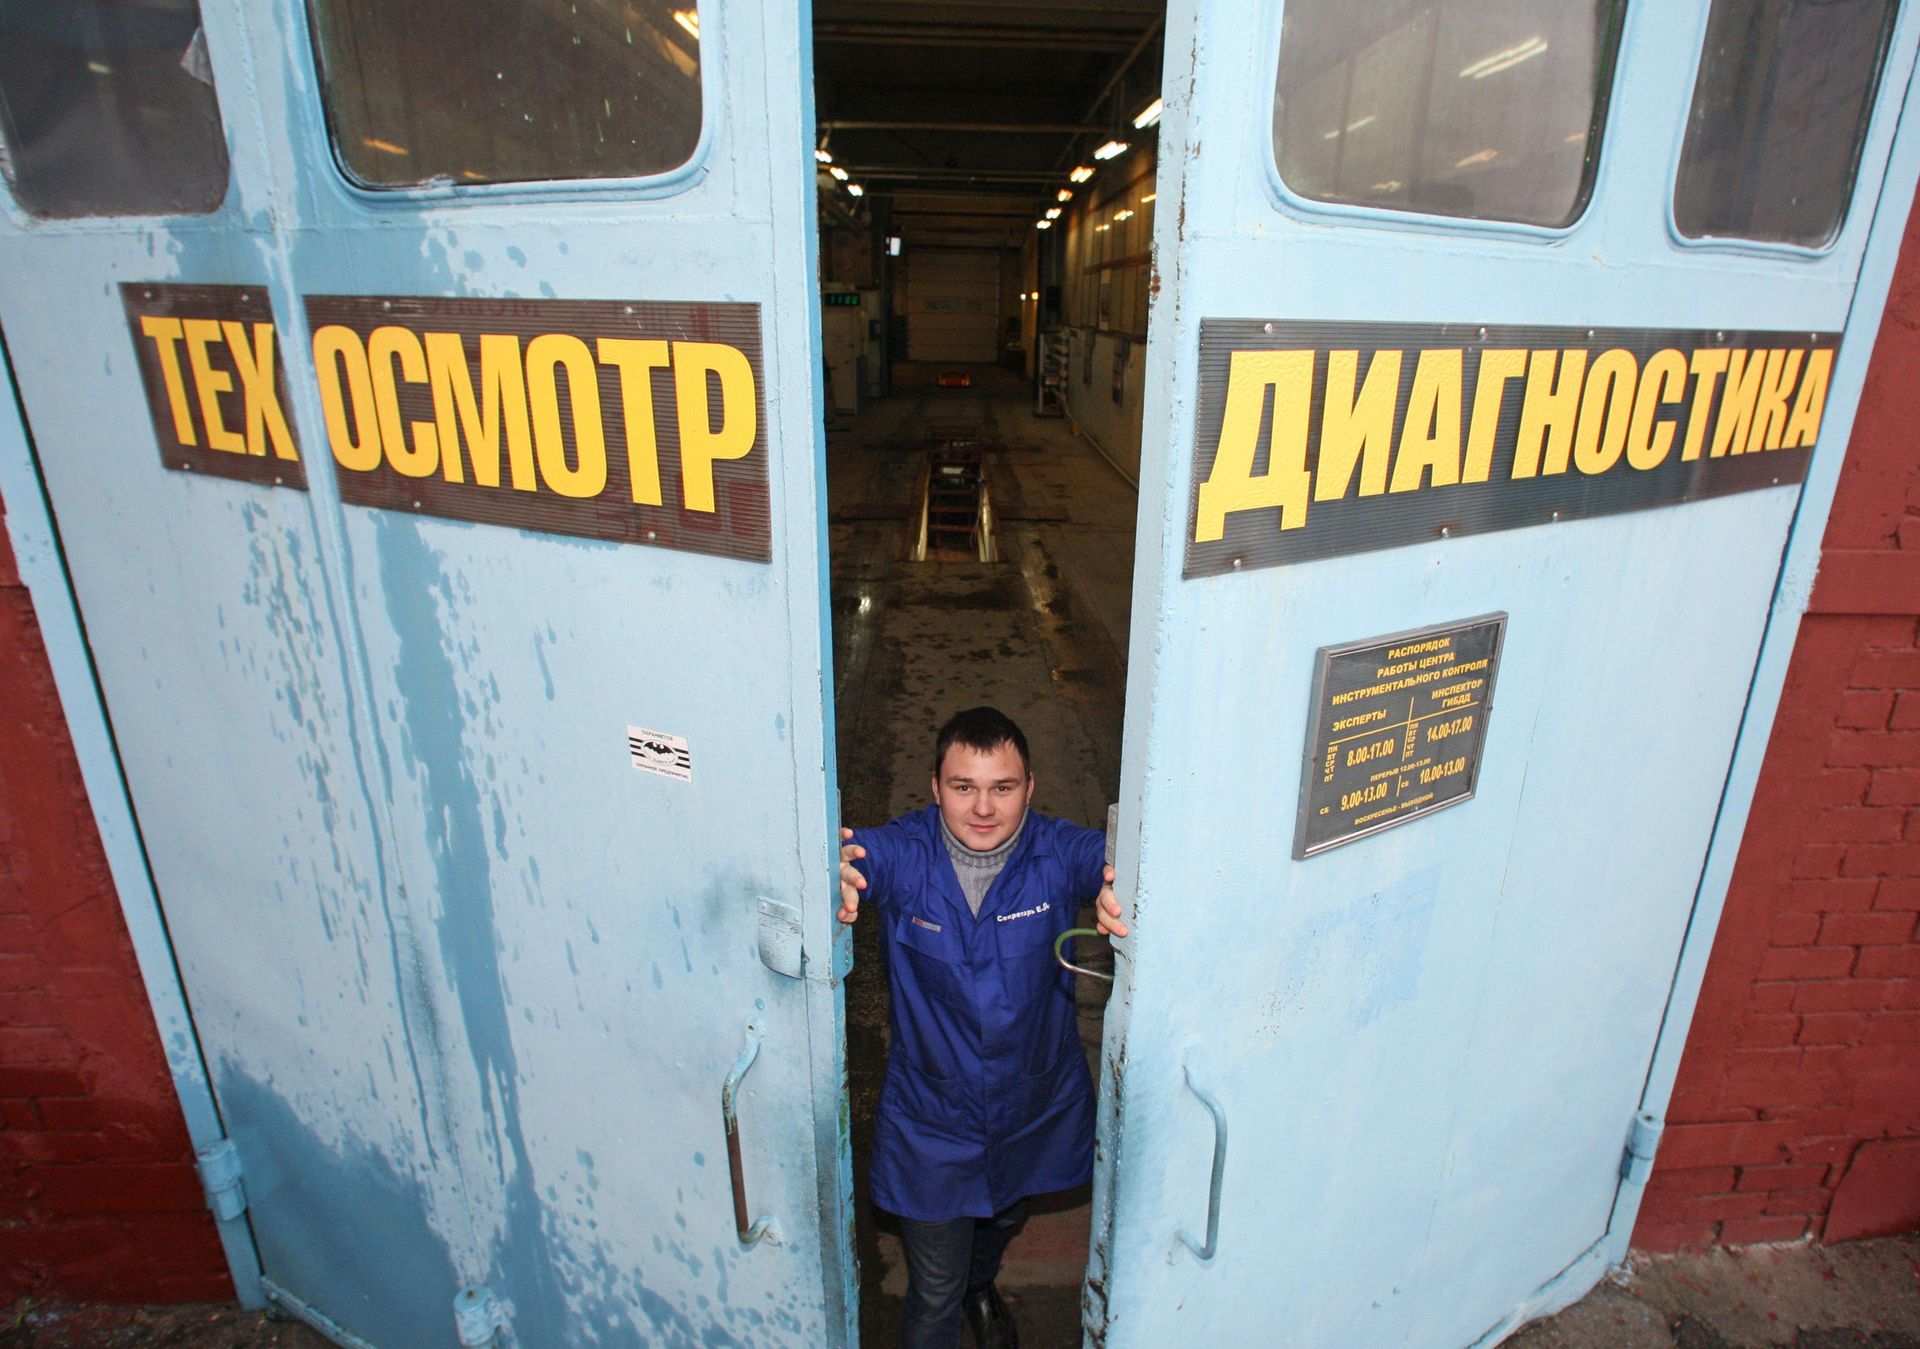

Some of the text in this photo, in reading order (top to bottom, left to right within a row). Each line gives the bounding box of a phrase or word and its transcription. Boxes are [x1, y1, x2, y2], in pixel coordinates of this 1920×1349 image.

[1195, 348, 1834, 543] ДИАГНОСТИКА
[1388, 637, 1452, 660] РАСПОРЯДОК
[1377, 652, 1456, 679] РАБОТЫ ЦЕНТРА
[1332, 659, 1489, 706] ИНСТРУМЕНТАЛЬНОГО КОНТРОЛЯ
[1432, 679, 1483, 699] ИНСПЕКТОР
[1442, 693, 1472, 709] ГИБДД
[1332, 709, 1387, 732] ЭКСПЕРТЫ
[1427, 716, 1473, 743] 14.00-17.00
[1347, 739, 1395, 768] 8.00-17.00
[1420, 757, 1466, 785] 10.00-13.00
[1341, 782, 1388, 811] 9.00-13.00
